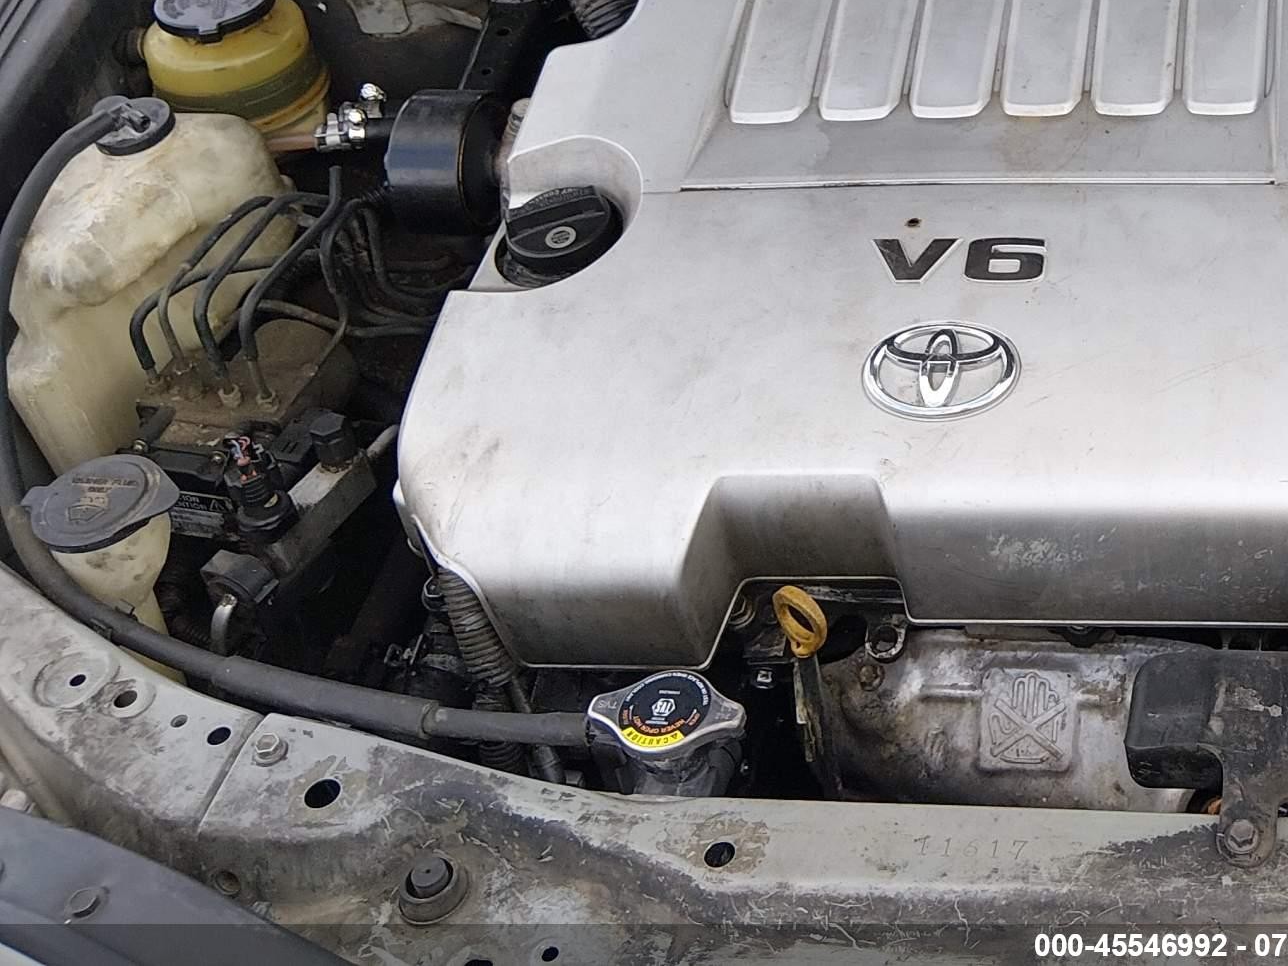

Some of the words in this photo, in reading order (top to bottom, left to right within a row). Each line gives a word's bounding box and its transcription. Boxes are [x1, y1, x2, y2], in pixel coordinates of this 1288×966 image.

[872, 237, 1047, 283] V6
[654, 700, 672, 714] TVS
[626, 731, 670, 747] CAUTION
